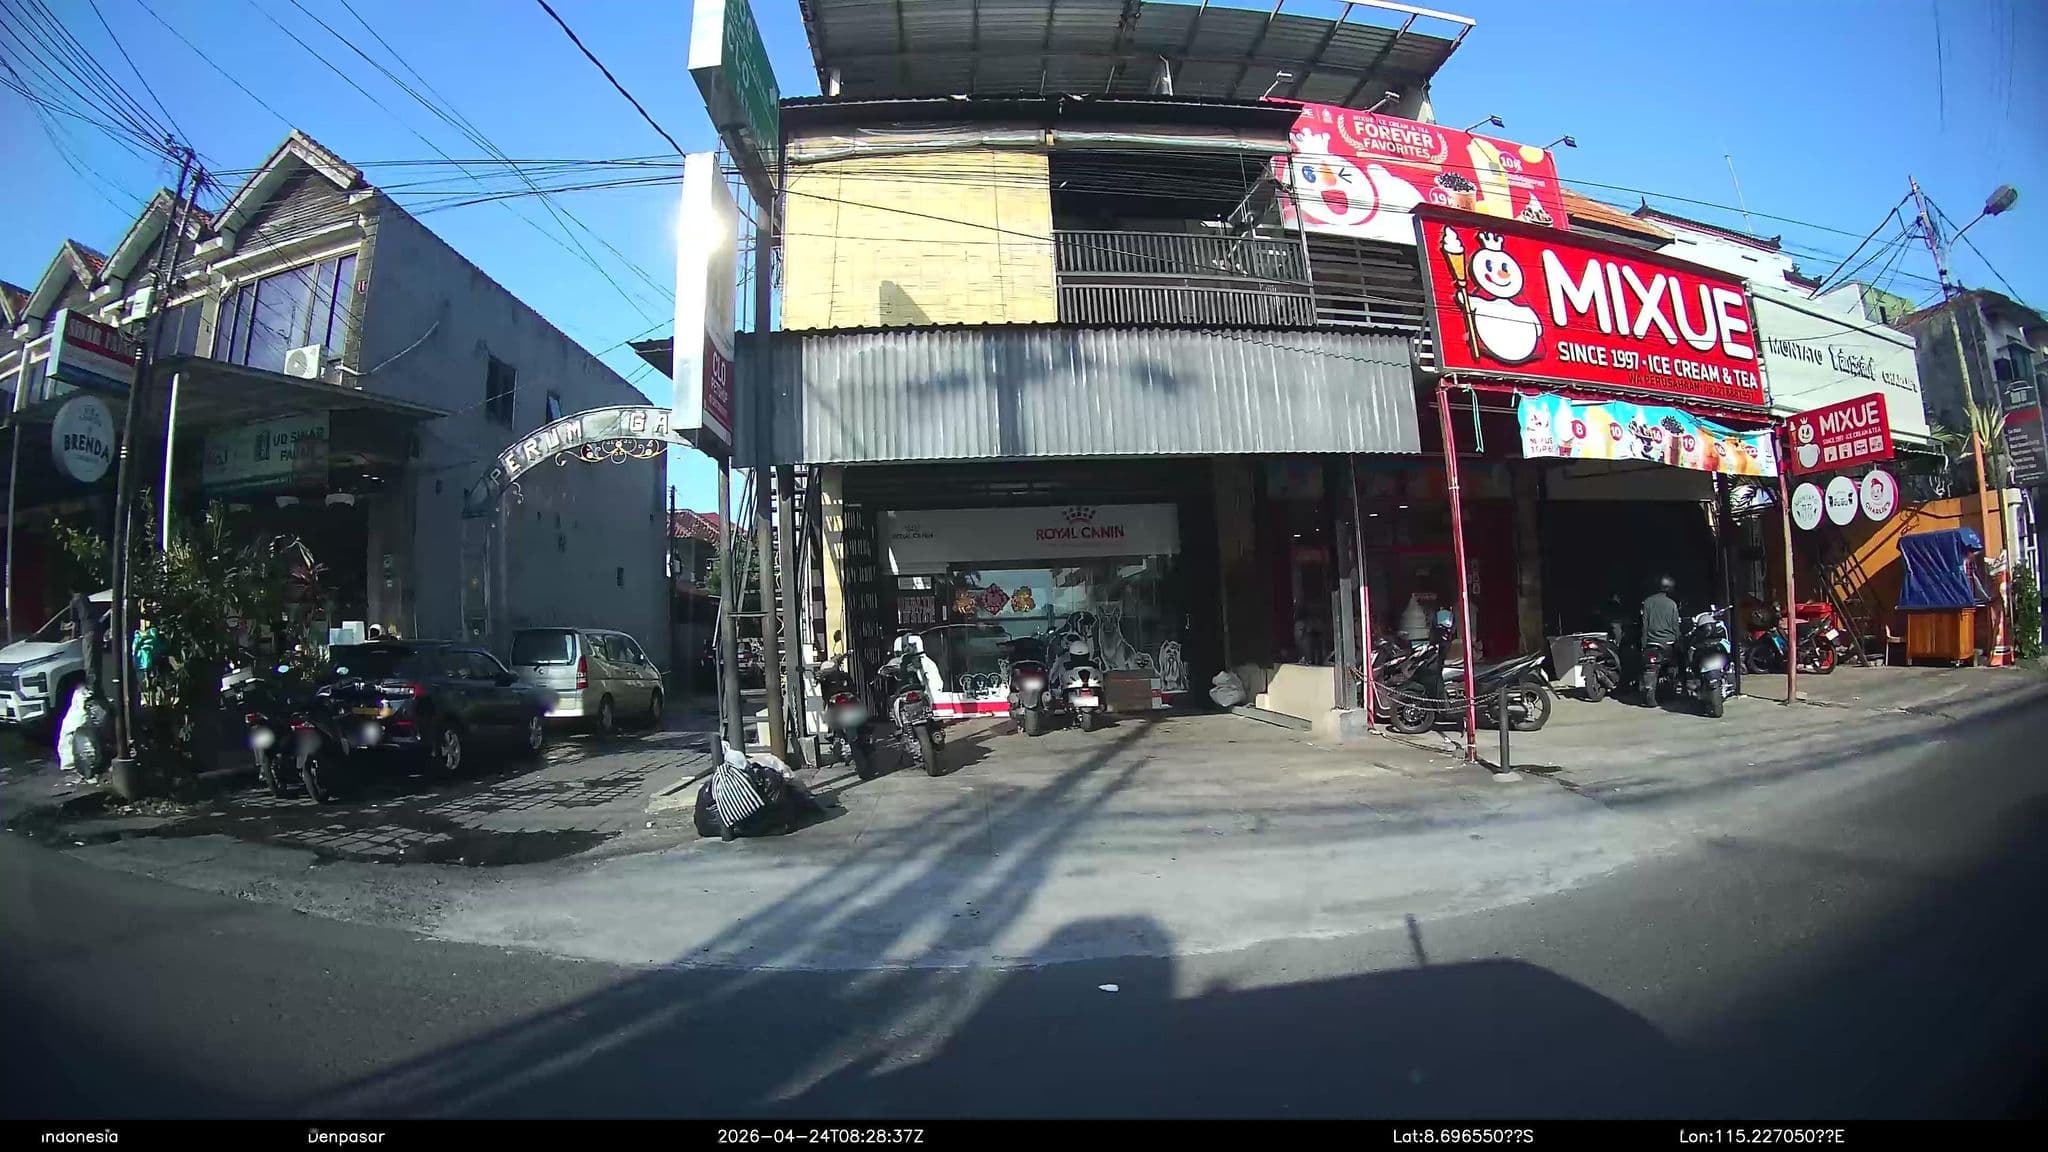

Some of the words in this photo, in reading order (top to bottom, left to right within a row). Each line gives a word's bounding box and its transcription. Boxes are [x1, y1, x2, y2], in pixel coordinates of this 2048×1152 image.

[1354, 121, 1435, 149] FOREVER
[1363, 137, 1431, 159] FAVORITES
[1542, 249, 1754, 360] MIXUE
[712, 351, 726, 387] CLO
[1557, 341, 1608, 366] SINCE
[1611, 349, 1640, 371] 1997
[1648, 354, 1672, 376] ICE
[1674, 359, 1720, 383] CREAM
[1722, 366, 1733, 386] &
[1733, 368, 1758, 389] TEA
[1575, 424, 1582, 434] 8
[1610, 425, 1622, 438] 10
[1819, 401, 1880, 437] MIXUE
[64, 434, 110, 463] BRENDA
[274, 432, 288, 446] UD
[490, 420, 583, 486] PERUM
[1684, 438, 1694, 450] 19
[1036, 527, 1078, 540] ROYAL
[1081, 524, 1124, 539] CANIN
